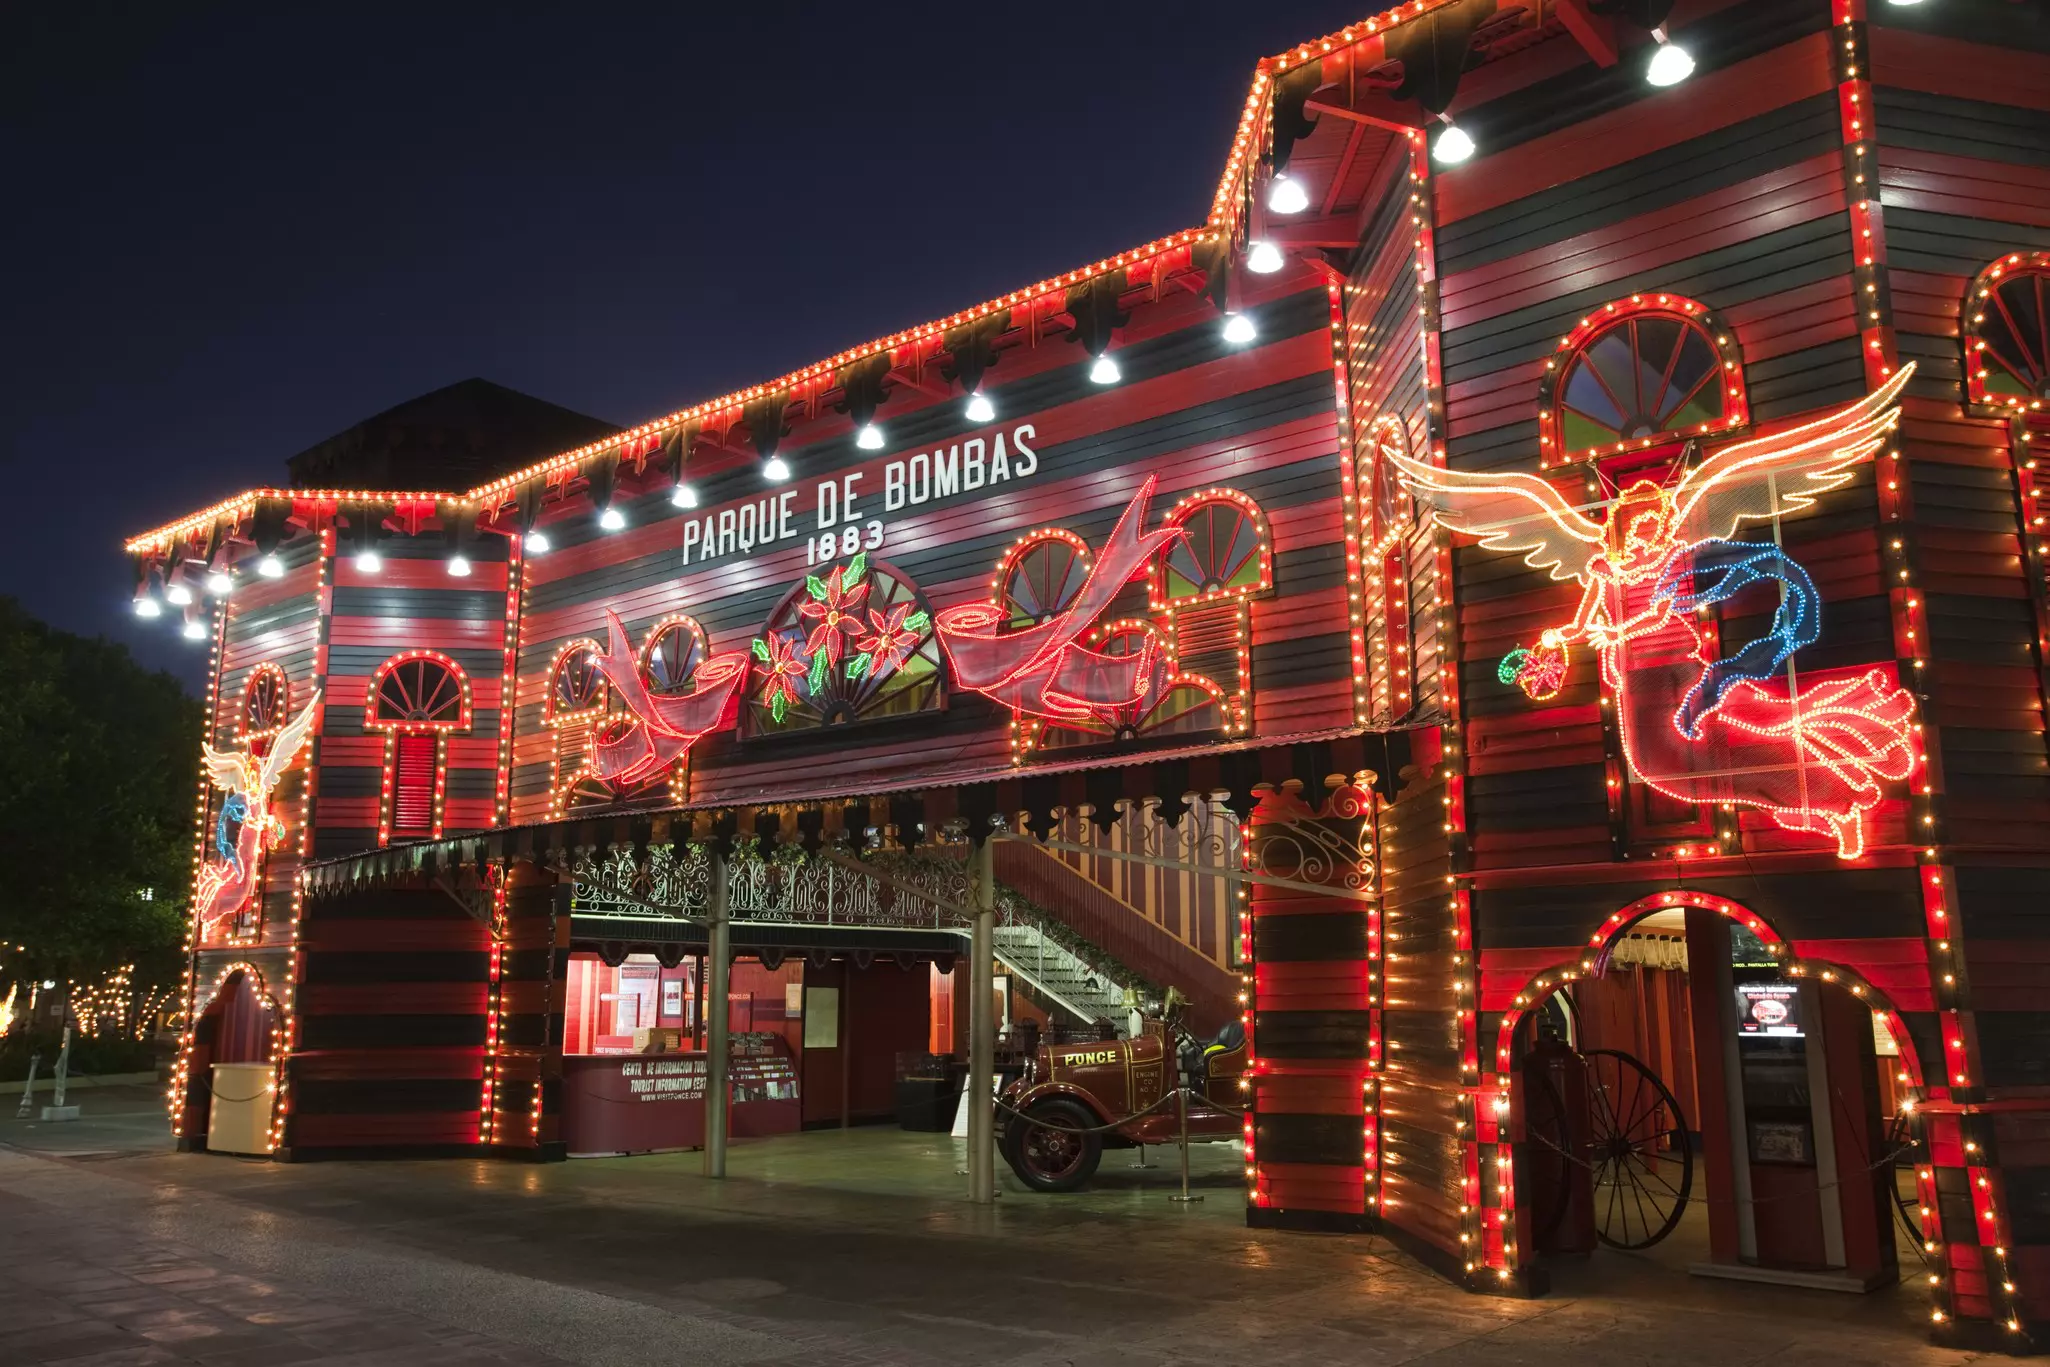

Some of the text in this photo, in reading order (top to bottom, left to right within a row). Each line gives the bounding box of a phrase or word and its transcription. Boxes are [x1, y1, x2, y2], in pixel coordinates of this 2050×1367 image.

[683, 424, 1038, 565] PARQUE DE BOMBAS
[808, 520, 885, 565] 1883
[1065, 1051, 1116, 1065] PONCE
[647, 1062, 654, 1075] DE
[655, 1061, 693, 1075] INFORMACION
[1136, 1071, 1158, 1079] ENGINE
[631, 1079, 654, 1093] TOURIST
[655, 1078, 692, 1091] INFORMATION
